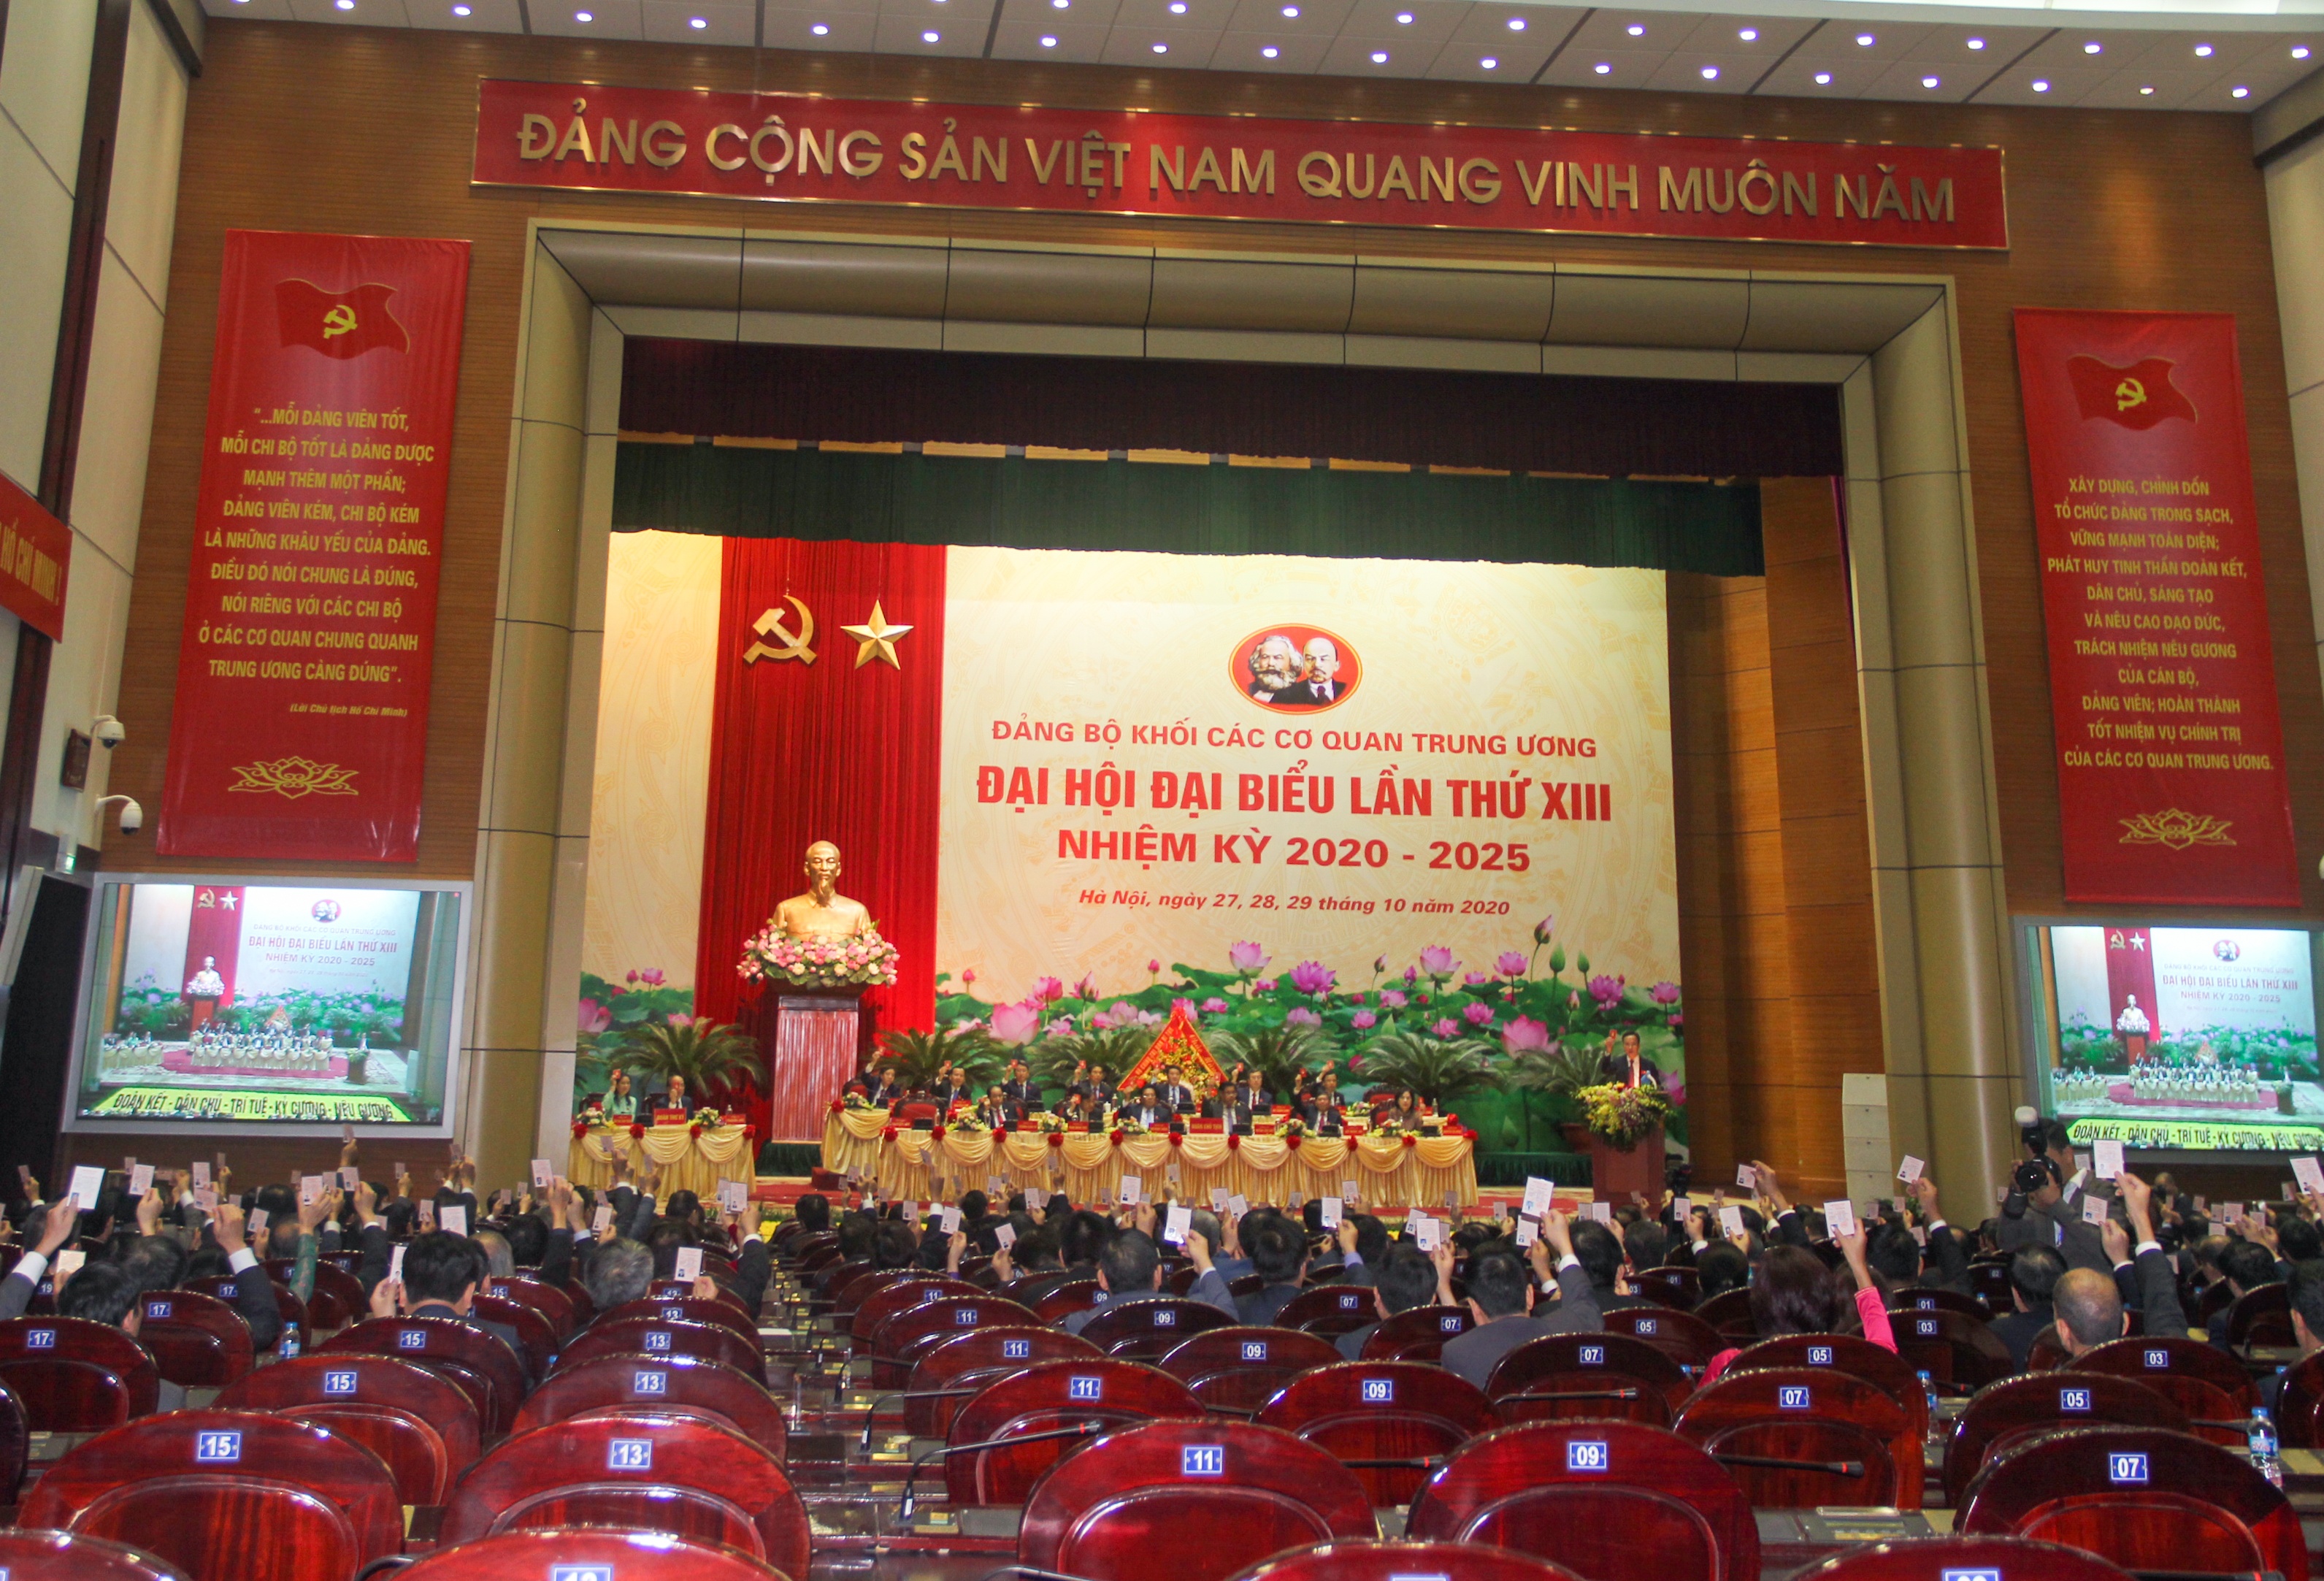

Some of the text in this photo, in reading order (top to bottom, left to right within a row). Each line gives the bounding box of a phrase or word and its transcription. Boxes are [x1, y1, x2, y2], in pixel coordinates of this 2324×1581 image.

[518, 98, 1955, 223] ĐẢNG CỘNG SẢN VIỆT NAM QUANG VINH MUÔN NĂM
[223, 494, 420, 527] ĐẢNG VIÊN KÉM, CHI BỘ KÉM
[204, 527, 431, 555] LÀ NHỮNG KHÂU YẾU CỦA ĐẢNG.
[211, 556, 418, 589] ĐIỀU ĐÓ NÓI CHUNG LÀ ĐÚNG,
[222, 592, 402, 623] NÓI RIÊNG VỚI CÁC CHI BỘ
[199, 619, 418, 650] Ở CÁC CƠ QUAN CHUNG QUANH
[209, 659, 256, 677] TRUNG
[261, 660, 302, 679] ƯƠNG
[305, 659, 345, 680] CÀNG
[992, 713, 1598, 758] ĐẢNG BỘ KHỐI CÁC CƠ QUAN TRUNG ƯƠNG
[977, 759, 1612, 822] ĐẠI HỘI ĐẠI BIỂU LẦN THỨ XIII
[1057, 824, 1197, 870] NHIỆM
[1213, 829, 1272, 865] KỲ
[1286, 837, 1389, 869] 2020
[1428, 841, 1531, 873] 2025
[1079, 889, 1511, 916] Hà Nội, ngày 27, 28, 29 tháng 10 năm 2020
[380, 942, 397, 952] XIII
[318, 956, 342, 964] 2020
[351, 957, 375, 966] 2025
[42, 1284, 53, 1293] 19
[223, 1286, 235, 1295] 17
[1629, 1285, 1638, 1293] 03
[929, 1292, 937, 1300] 11
[1097, 1293, 1108, 1301] 09
[154, 1305, 166, 1314] 17
[1921, 1301, 1930, 1309] 01
[667, 1310, 678, 1319] 13
[962, 1313, 972, 1322] 11
[1159, 1314, 1170, 1322] 09
[1445, 1319, 1457, 1329] 07
[1641, 1322, 1652, 1331] 05
[1921, 1323, 1933, 1332] 03
[34, 1333, 50, 1345] 17
[406, 1333, 421, 1345] 15
[651, 1335, 665, 1347] 13
[1010, 1343, 1022, 1354] 11
[1247, 1345, 1261, 1357] 09
[1584, 1349, 1598, 1360] 07
[1813, 1350, 1827, 1361] 05
[2149, 1353, 2163, 1364] 03
[332, 1374, 350, 1390] 15
[641, 1374, 660, 1390] 13
[1077, 1380, 1094, 1396] 11
[1368, 1382, 1386, 1398] 09
[1785, 1389, 1802, 1405] 07
[2066, 1393, 2084, 1406] 05
[206, 1435, 232, 1457] 15
[619, 1445, 643, 1465] 13
[1193, 1450, 1213, 1470] 11
[1576, 1445, 1600, 1466] 09
[2117, 1458, 2139, 1477] 07
